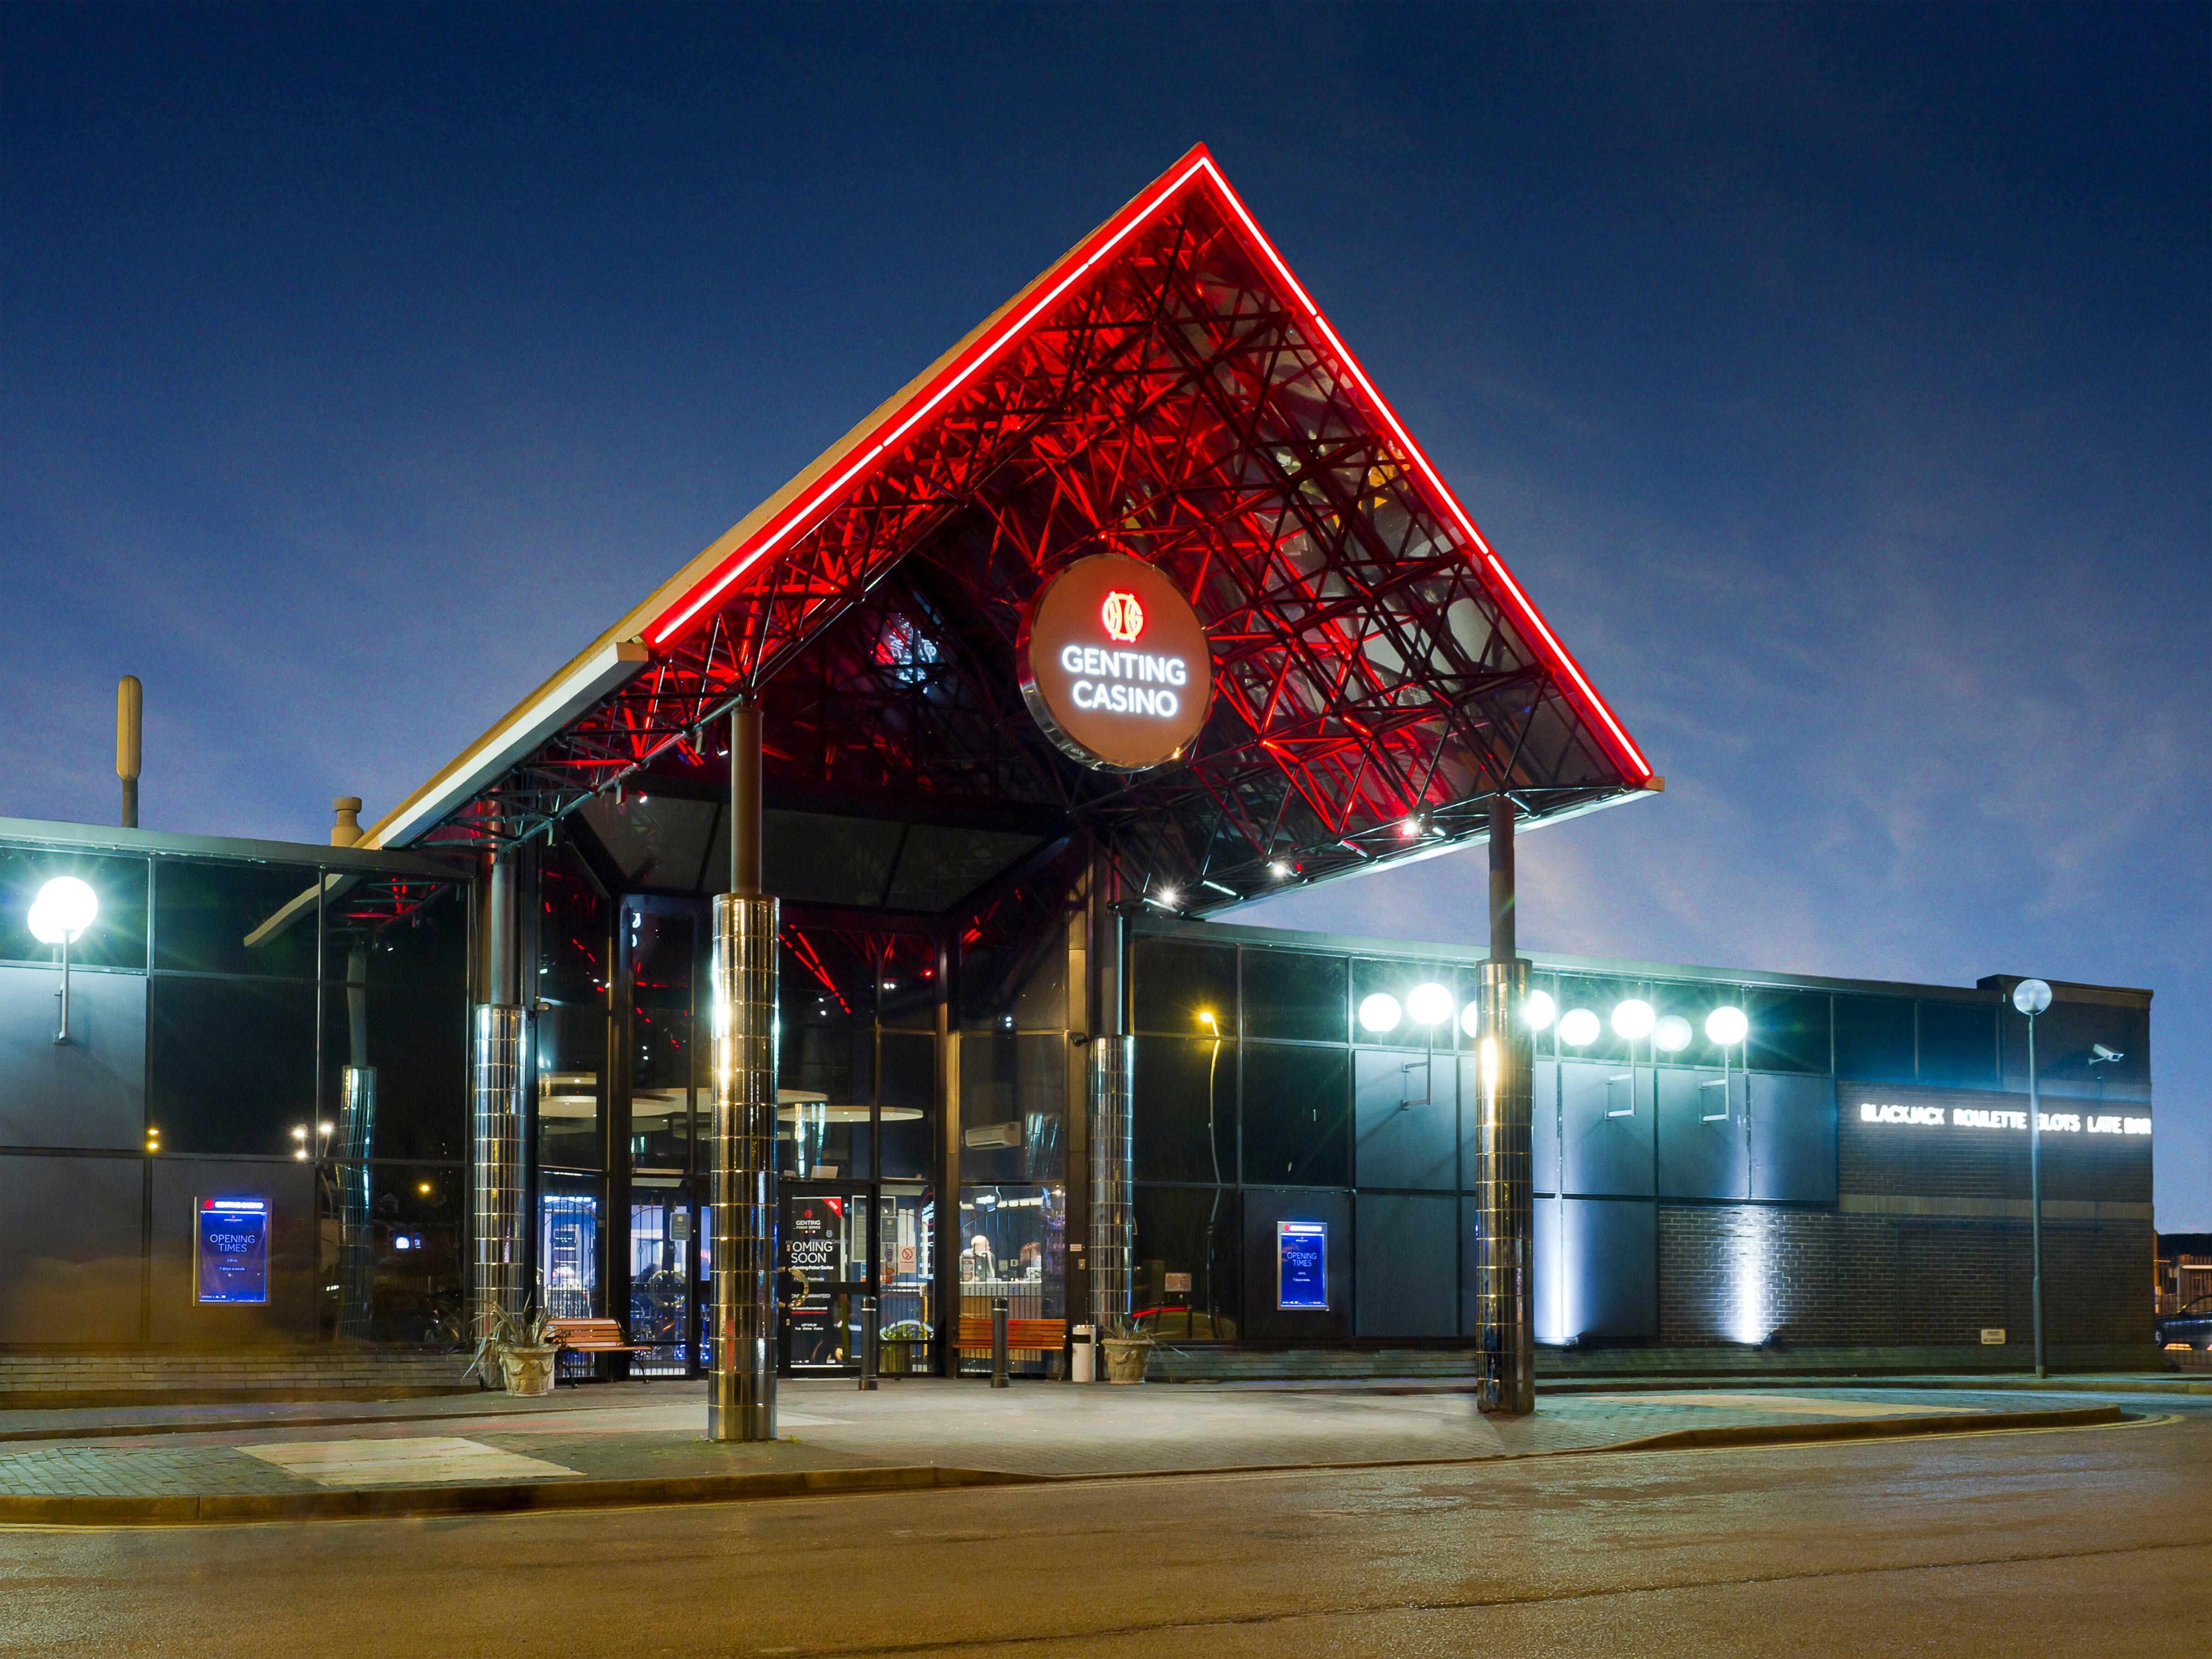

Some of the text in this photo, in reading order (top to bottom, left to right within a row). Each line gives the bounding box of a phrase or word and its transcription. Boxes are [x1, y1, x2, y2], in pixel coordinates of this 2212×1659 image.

[1062, 646, 1186, 685] GENTING
[1073, 681, 1178, 717] CASINO
[1860, 1103, 1945, 1125] BLACKJACK
[1953, 1108, 2027, 1129] ROULETTE
[2087, 1116, 2122, 1133] LATE
[2124, 1117, 2151, 1134] BAR
[210, 1234, 255, 1243] OPENING
[218, 1243, 247, 1252] TIMES
[792, 1241, 833, 1252] OMING
[791, 1253, 826, 1263] SOON
